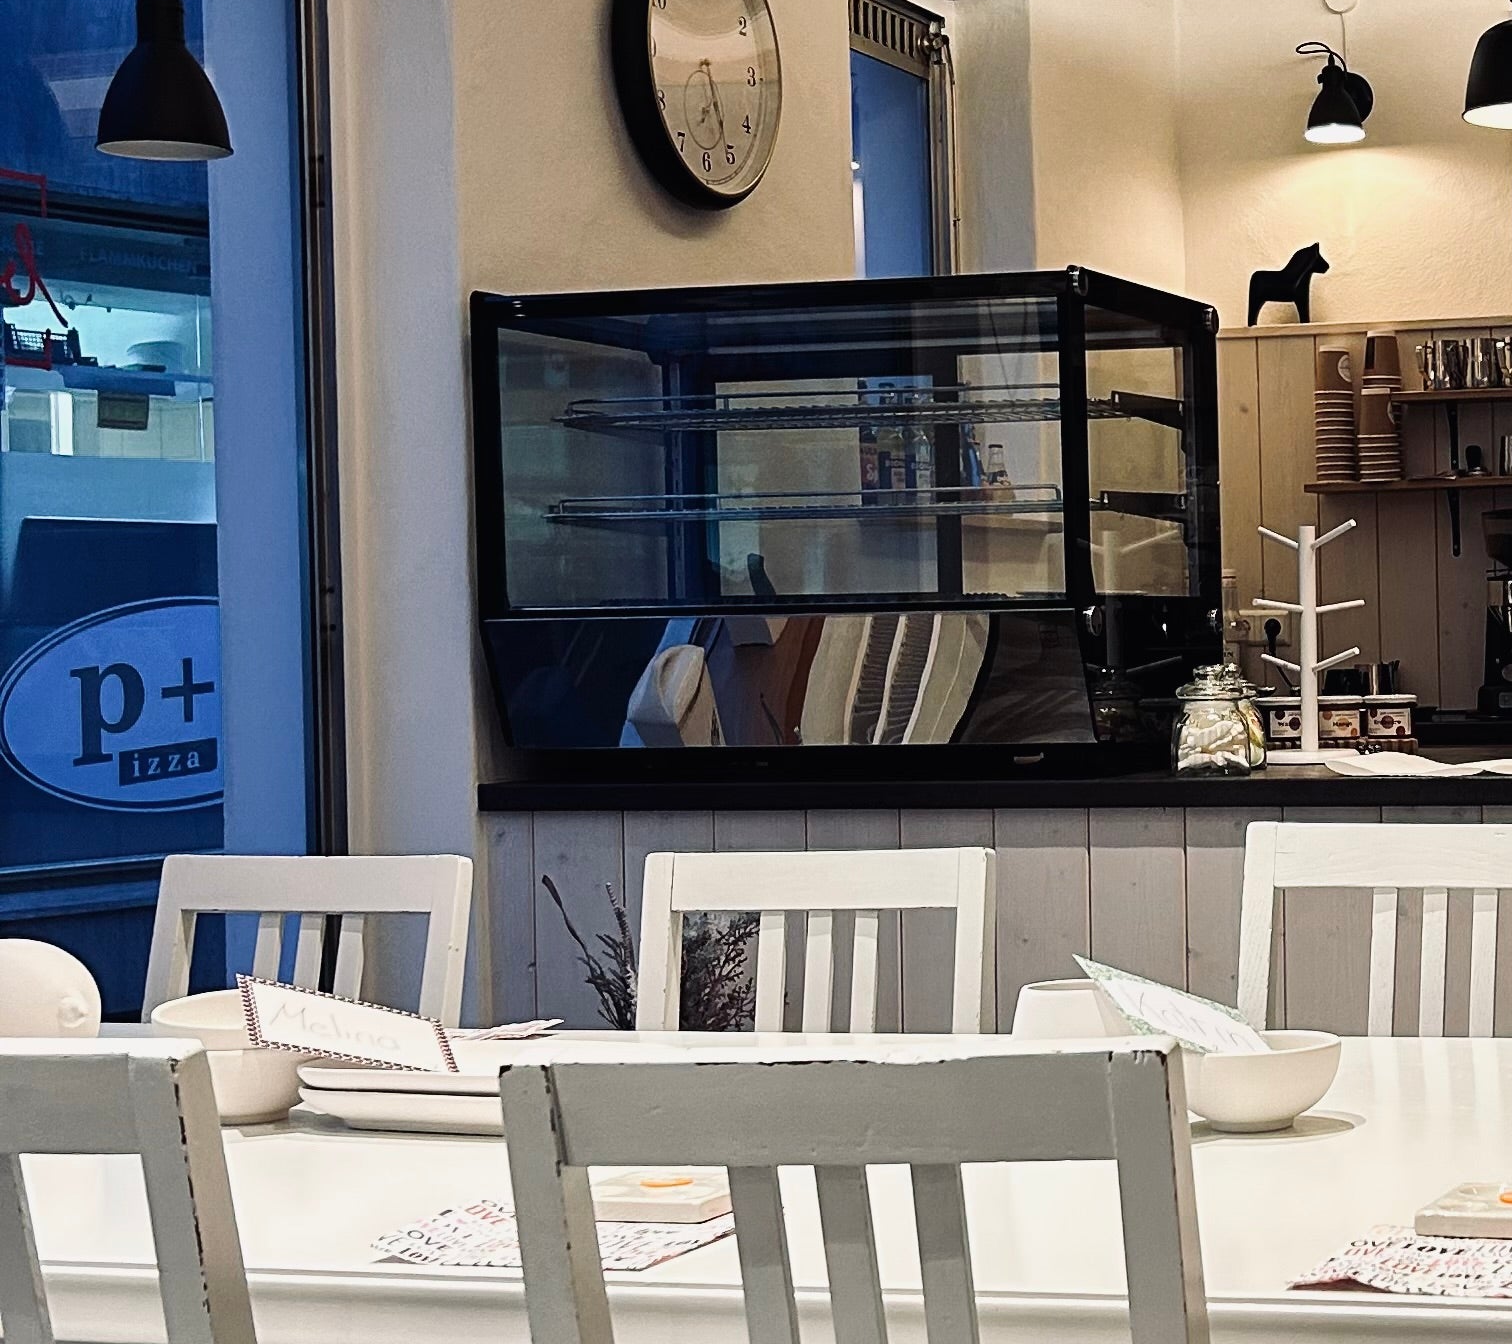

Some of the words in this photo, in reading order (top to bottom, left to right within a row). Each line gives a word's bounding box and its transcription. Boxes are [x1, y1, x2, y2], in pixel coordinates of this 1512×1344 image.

[738, 15, 747, 37] 2
[746, 66, 757, 87] 3
[741, 114, 752, 135] 4
[676, 131, 686, 153] 7
[702, 151, 712, 173] 6
[725, 143, 736, 165] 5
[132, 748, 201, 778] izza
[269, 1001, 400, 1051] Melina
